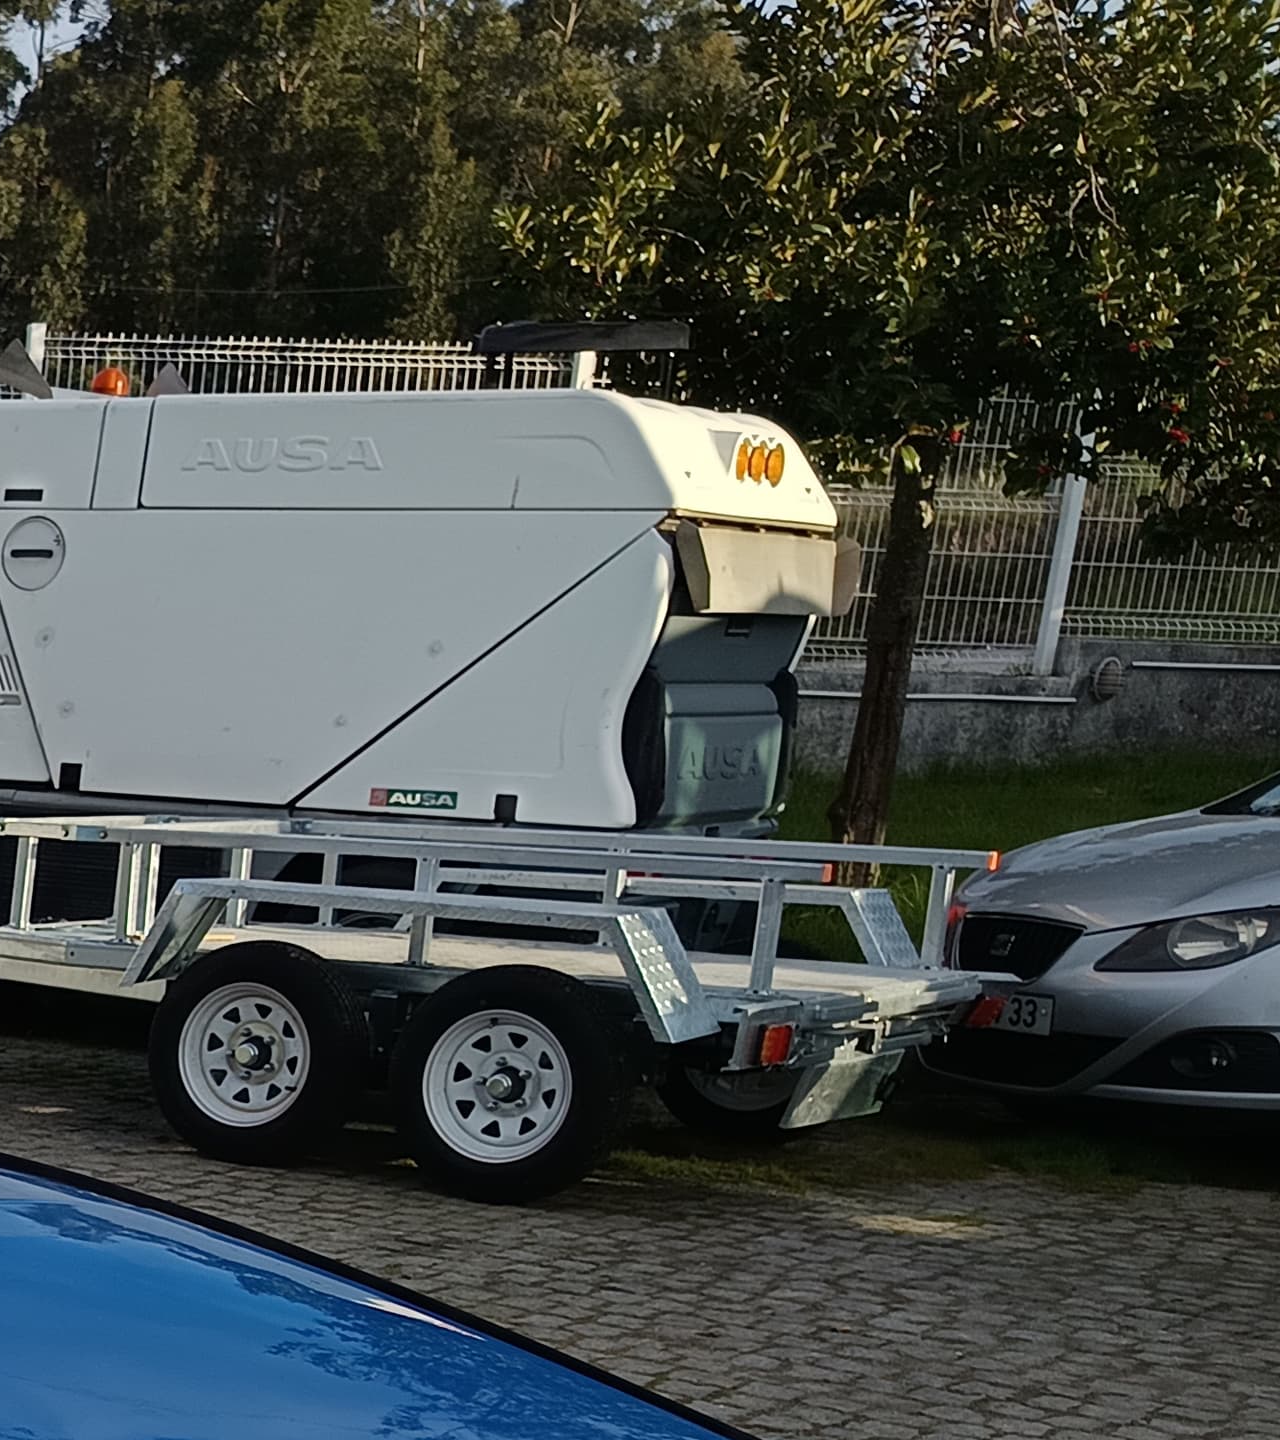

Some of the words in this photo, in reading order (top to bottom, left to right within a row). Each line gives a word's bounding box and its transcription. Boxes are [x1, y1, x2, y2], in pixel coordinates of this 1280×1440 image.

[180, 434, 385, 473] AUSA
[676, 744, 761, 781] AUSA
[388, 791, 455, 807] AUSA
[1007, 996, 1038, 1028] 33
